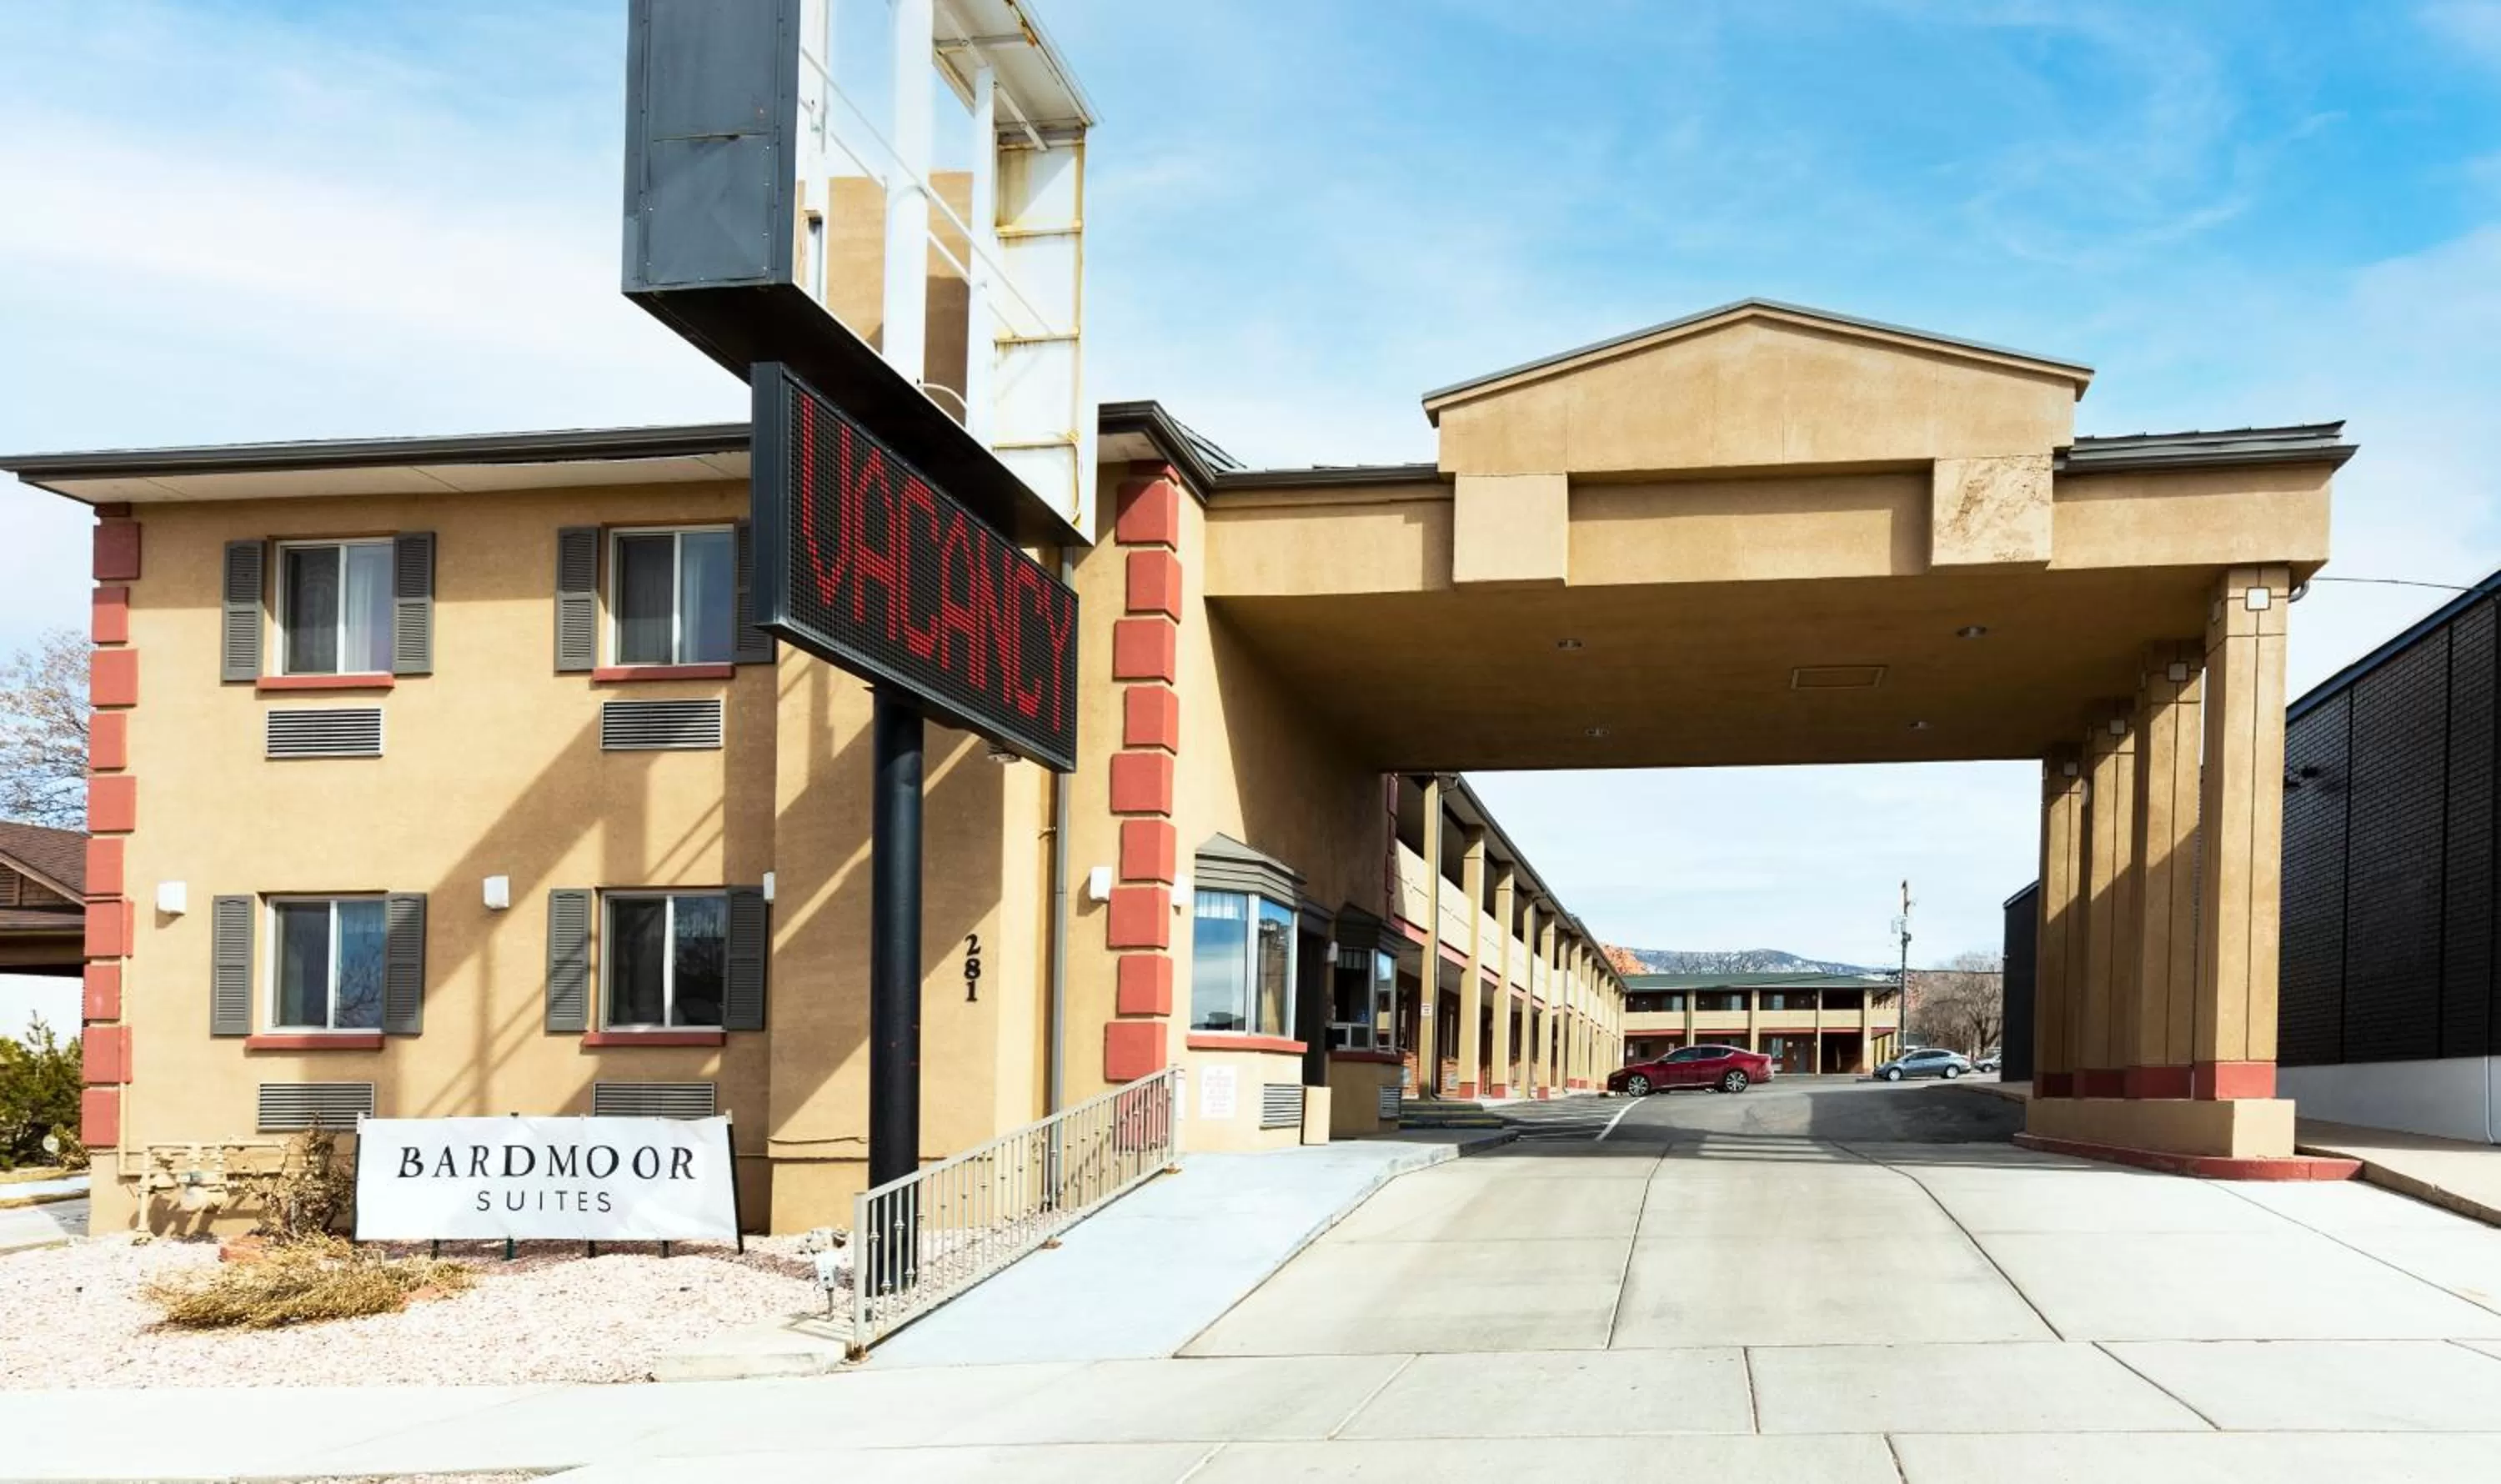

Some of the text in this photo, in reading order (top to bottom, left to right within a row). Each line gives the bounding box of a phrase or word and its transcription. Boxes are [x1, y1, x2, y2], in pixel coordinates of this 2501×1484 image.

[802, 394, 1071, 732] VACANCY
[964, 933, 981, 1002] 281
[397, 1144, 696, 1180] BARDMOOR
[476, 1191, 612, 1213] SUITES
